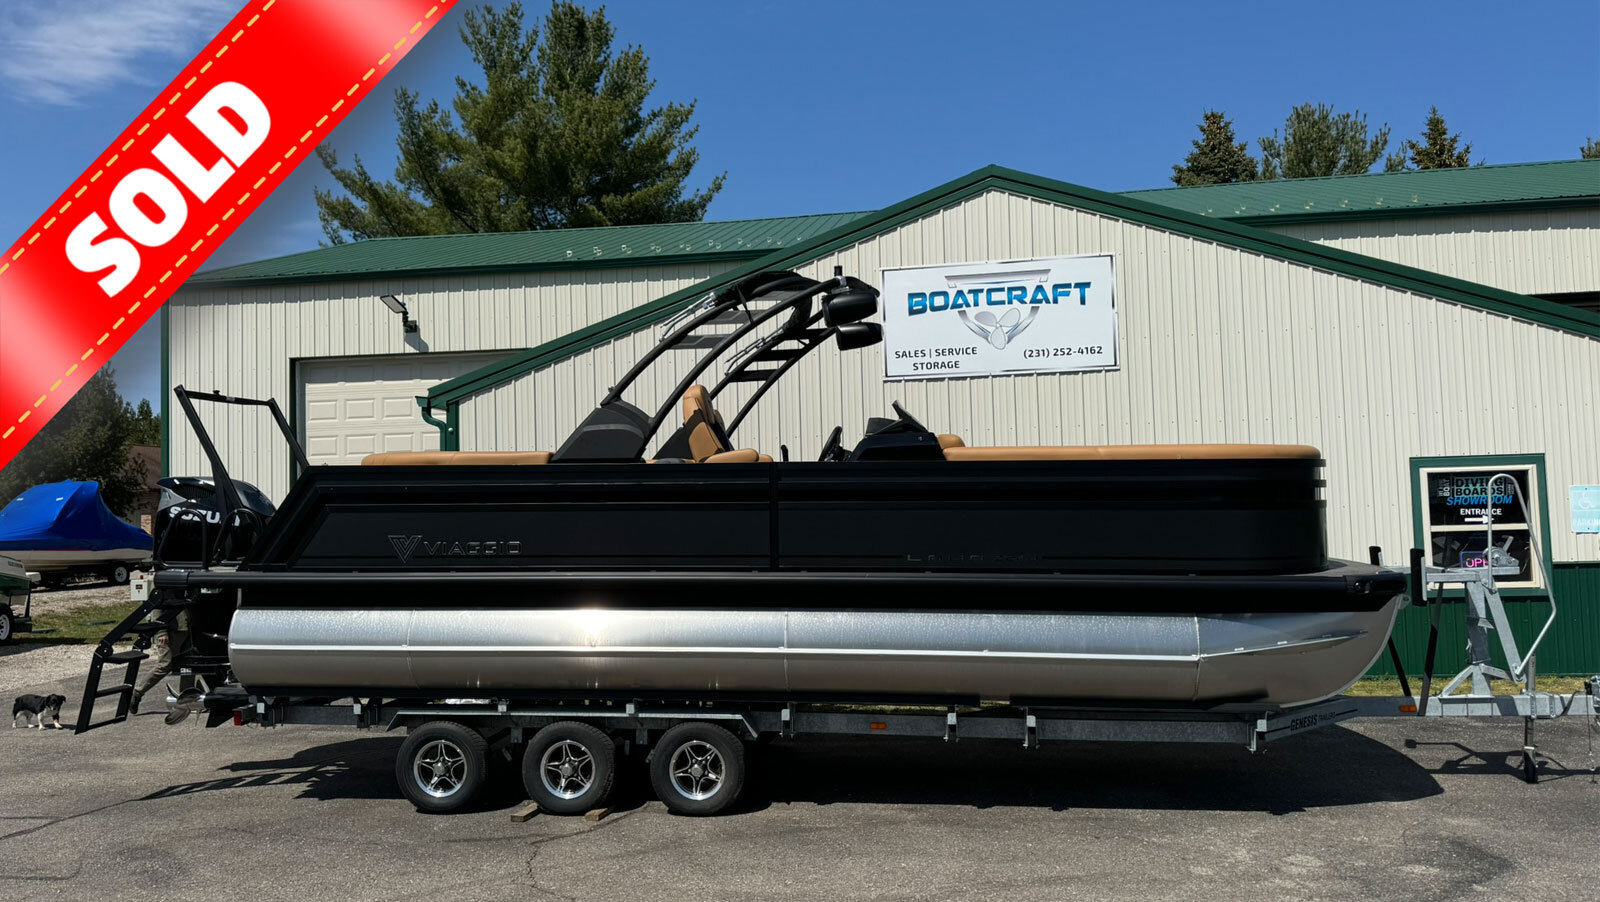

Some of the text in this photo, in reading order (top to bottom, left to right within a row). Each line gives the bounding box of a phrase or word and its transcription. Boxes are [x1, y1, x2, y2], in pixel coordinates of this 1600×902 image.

[907, 281, 1091, 316] BOATCRAFT
[895, 346, 978, 359] SALES SERVICE
[1023, 346, 1103, 359] (231) 252-4162
[913, 361, 960, 371] STORAGE
[1456, 478, 1503, 487] DIVING
[1456, 487, 1503, 496] BOARDS
[1447, 495, 1513, 506] SHOWROOM
[169, 506, 241, 527] SUZUI
[1572, 518, 1600, 527] PARKIN
[423, 541, 522, 555] VIAGGIO
[1465, 557, 1489, 568] OPE
[1290, 713, 1318, 731] GENESIS
